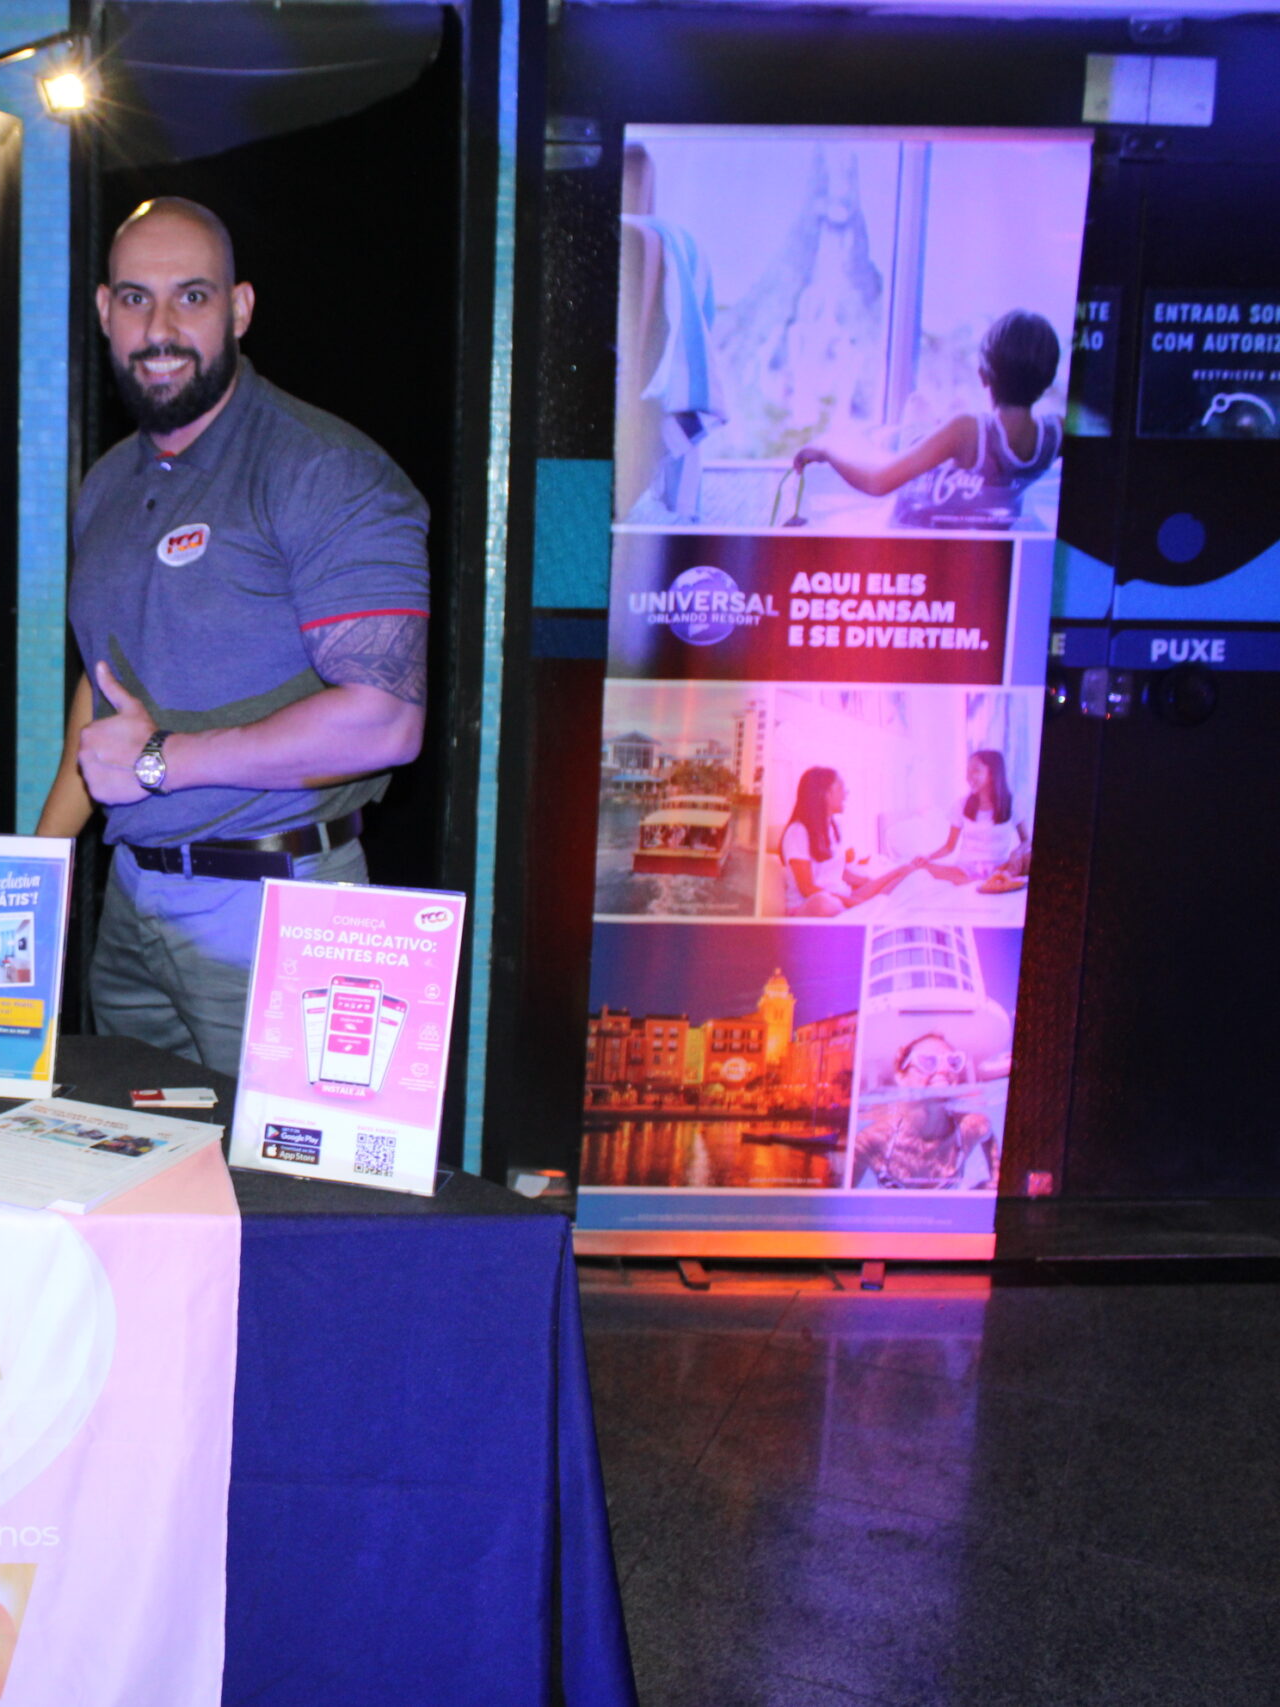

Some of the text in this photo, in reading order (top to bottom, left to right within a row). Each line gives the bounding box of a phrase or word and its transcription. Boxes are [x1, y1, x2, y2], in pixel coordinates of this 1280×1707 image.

[1153, 303, 1239, 323] ENTRADA
[1152, 333, 1194, 352] COM
[790, 572, 926, 595] AQUI ELES
[629, 591, 780, 617] UNIVERSAL
[789, 599, 955, 623] DESCANSAM
[647, 613, 761, 626] ORLANDO RESORT
[788, 625, 989, 650] E SE DIVERTEM.
[1150, 638, 1226, 663] PUXE
[332, 915, 386, 931] CONHEÇA
[280, 925, 438, 953] NOSSO APLICATIVO:
[302, 944, 410, 967] AGENTES RCA
[280, 1131, 305, 1143] Google
[305, 1134, 320, 1146] Play
[280, 1151, 316, 1162] App Store
